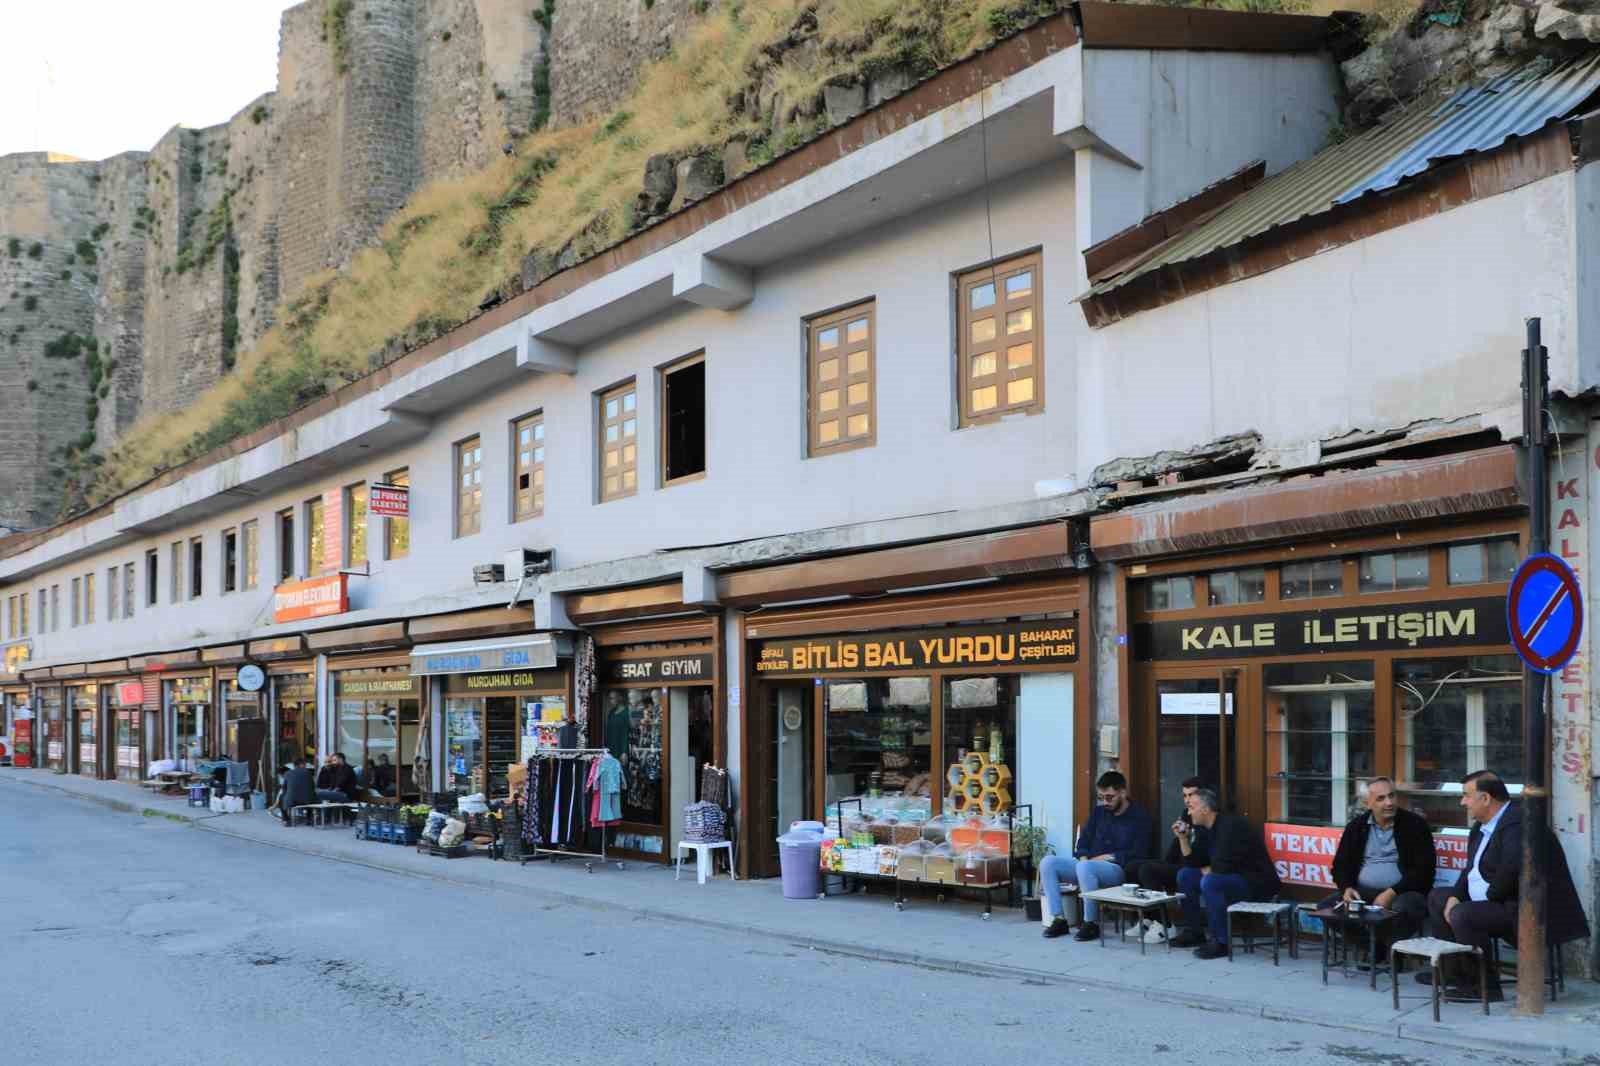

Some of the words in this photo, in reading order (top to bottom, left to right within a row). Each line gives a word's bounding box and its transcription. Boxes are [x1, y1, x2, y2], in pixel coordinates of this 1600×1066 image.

[1020, 628, 1074, 642] BAHARAT
[1181, 622, 1276, 650] KALE
[792, 640, 859, 670] BİTLİS
[864, 641, 913, 667] BAL
[919, 634, 1015, 664] YURDU
[1019, 642, 1075, 660] ÇEŞİTLERİ
[615, 662, 653, 678] ERAT
[513, 673, 534, 686] GIDA
[1271, 832, 1342, 856] TEKN
